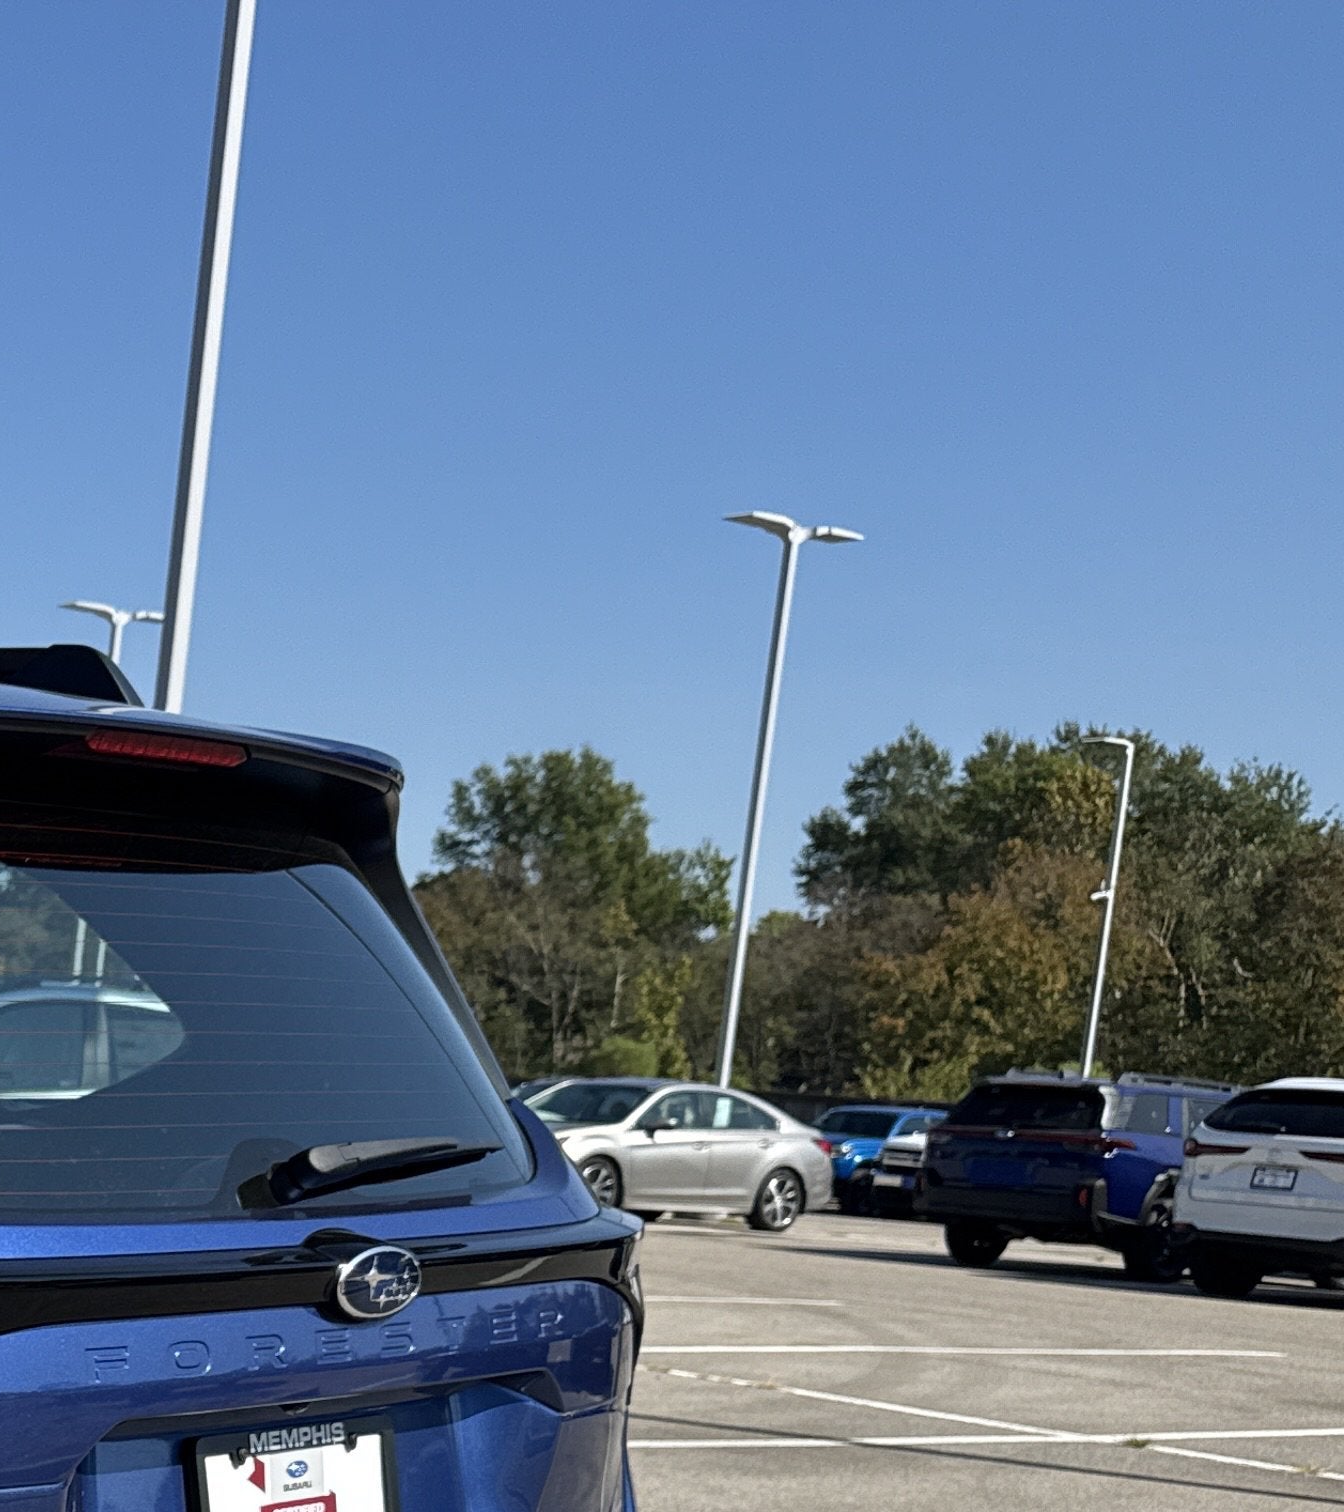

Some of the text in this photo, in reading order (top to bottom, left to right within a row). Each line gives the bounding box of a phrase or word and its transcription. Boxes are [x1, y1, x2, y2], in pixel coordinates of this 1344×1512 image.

[85, 1309, 565, 1385] FORESTER
[249, 1422, 345, 1453] MEMPHIS
[283, 1480, 312, 1492] SUBARU
